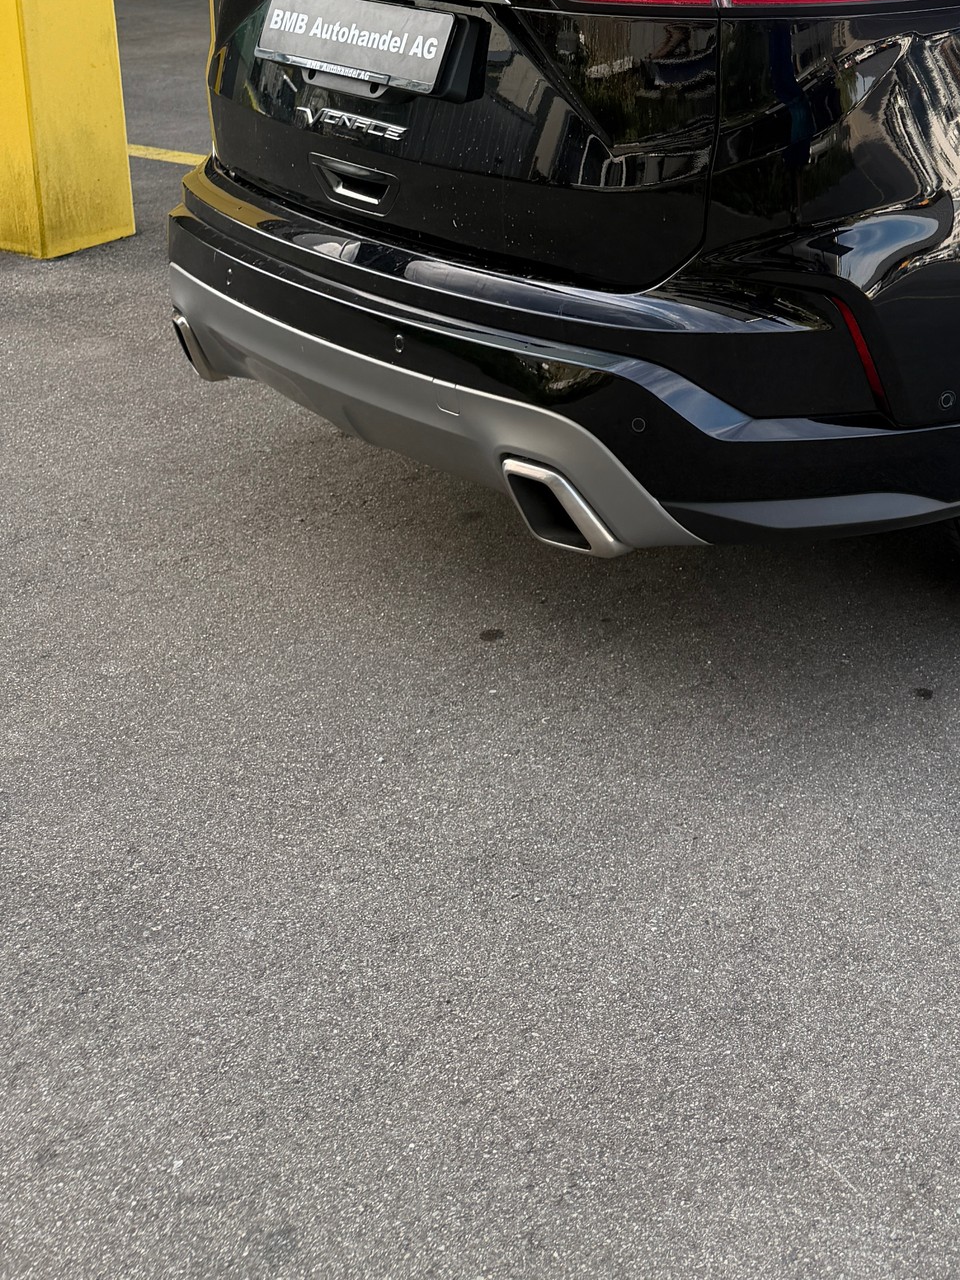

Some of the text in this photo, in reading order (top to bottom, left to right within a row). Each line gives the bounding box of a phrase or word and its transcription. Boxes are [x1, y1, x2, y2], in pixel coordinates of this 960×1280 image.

[269, 9, 438, 60] BMB Autohandel AG
[321, 62, 360, 78] Autohandel
[358, 72, 370, 81] AG
